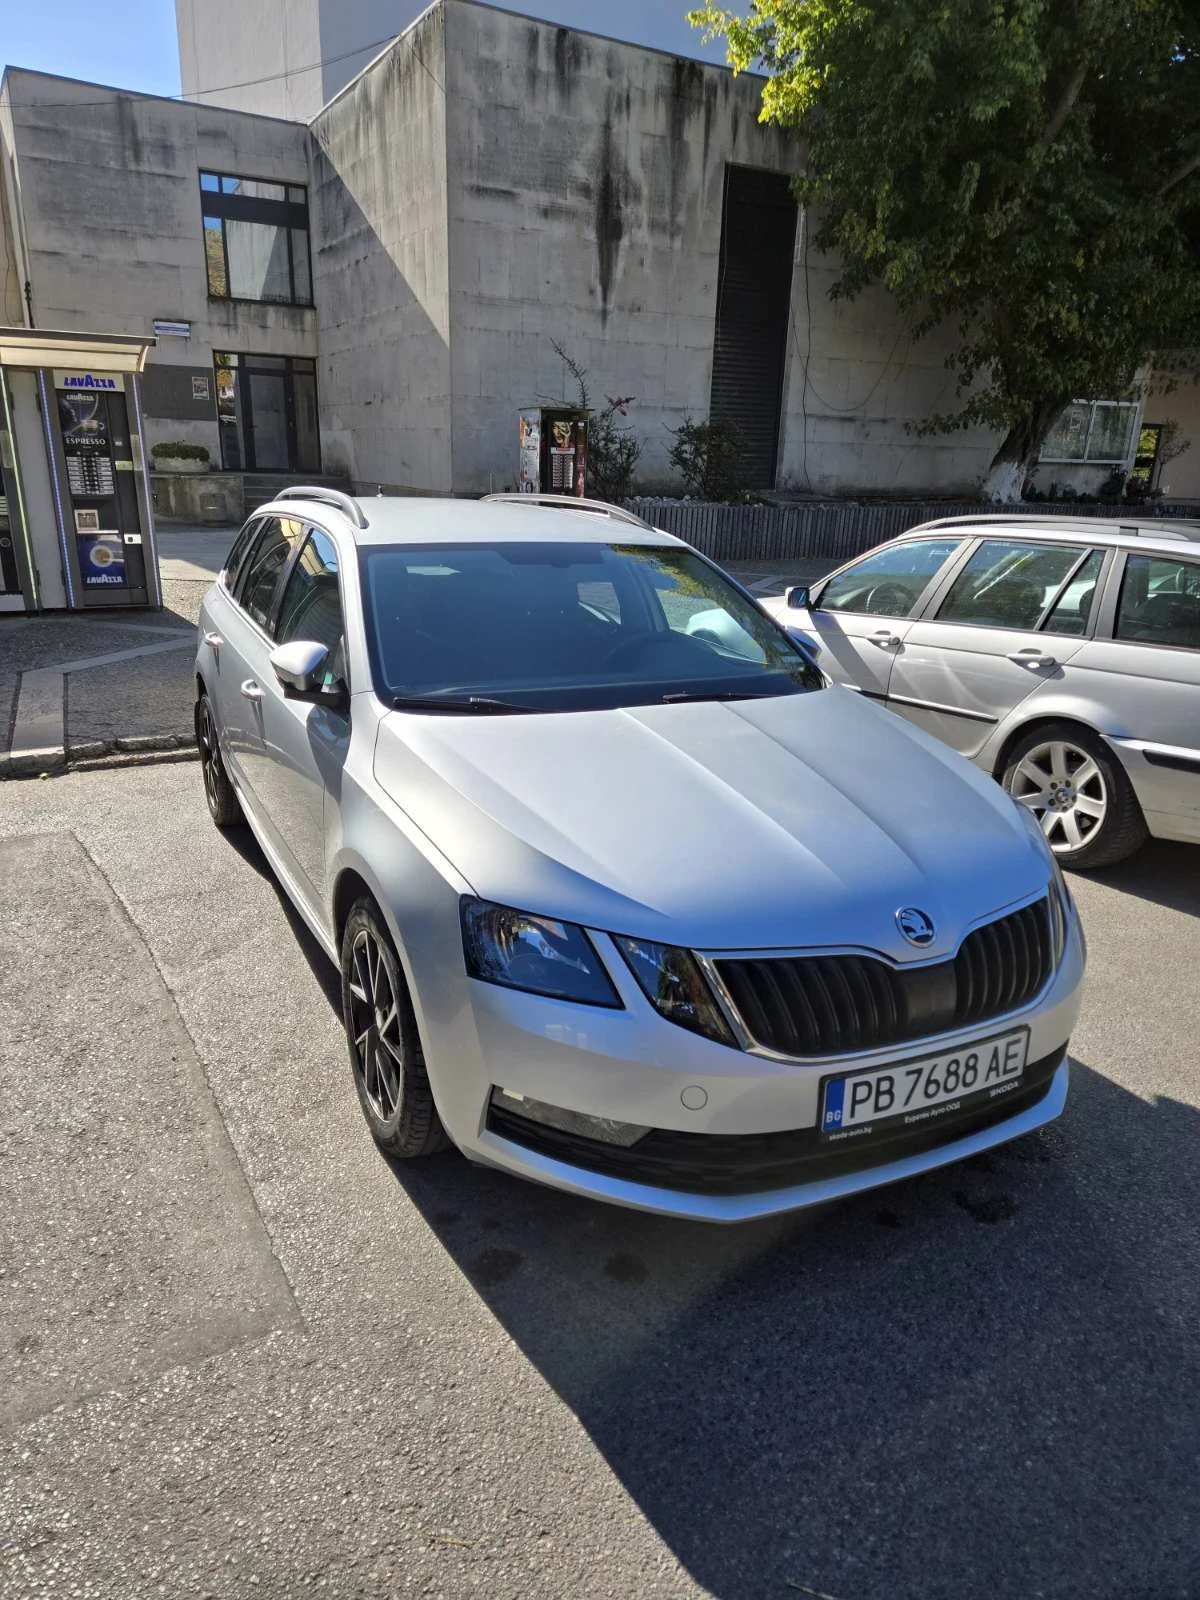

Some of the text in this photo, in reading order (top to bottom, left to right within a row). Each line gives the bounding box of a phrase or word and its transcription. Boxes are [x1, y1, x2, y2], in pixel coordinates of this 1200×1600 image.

[64, 374, 116, 389] LAVAZZA
[65, 437, 106, 446] ESPRESSO
[86, 573, 123, 584] LAVAZZA
[850, 1038, 1023, 1120] PB 7688 AE
[826, 1110, 842, 1123] BG
